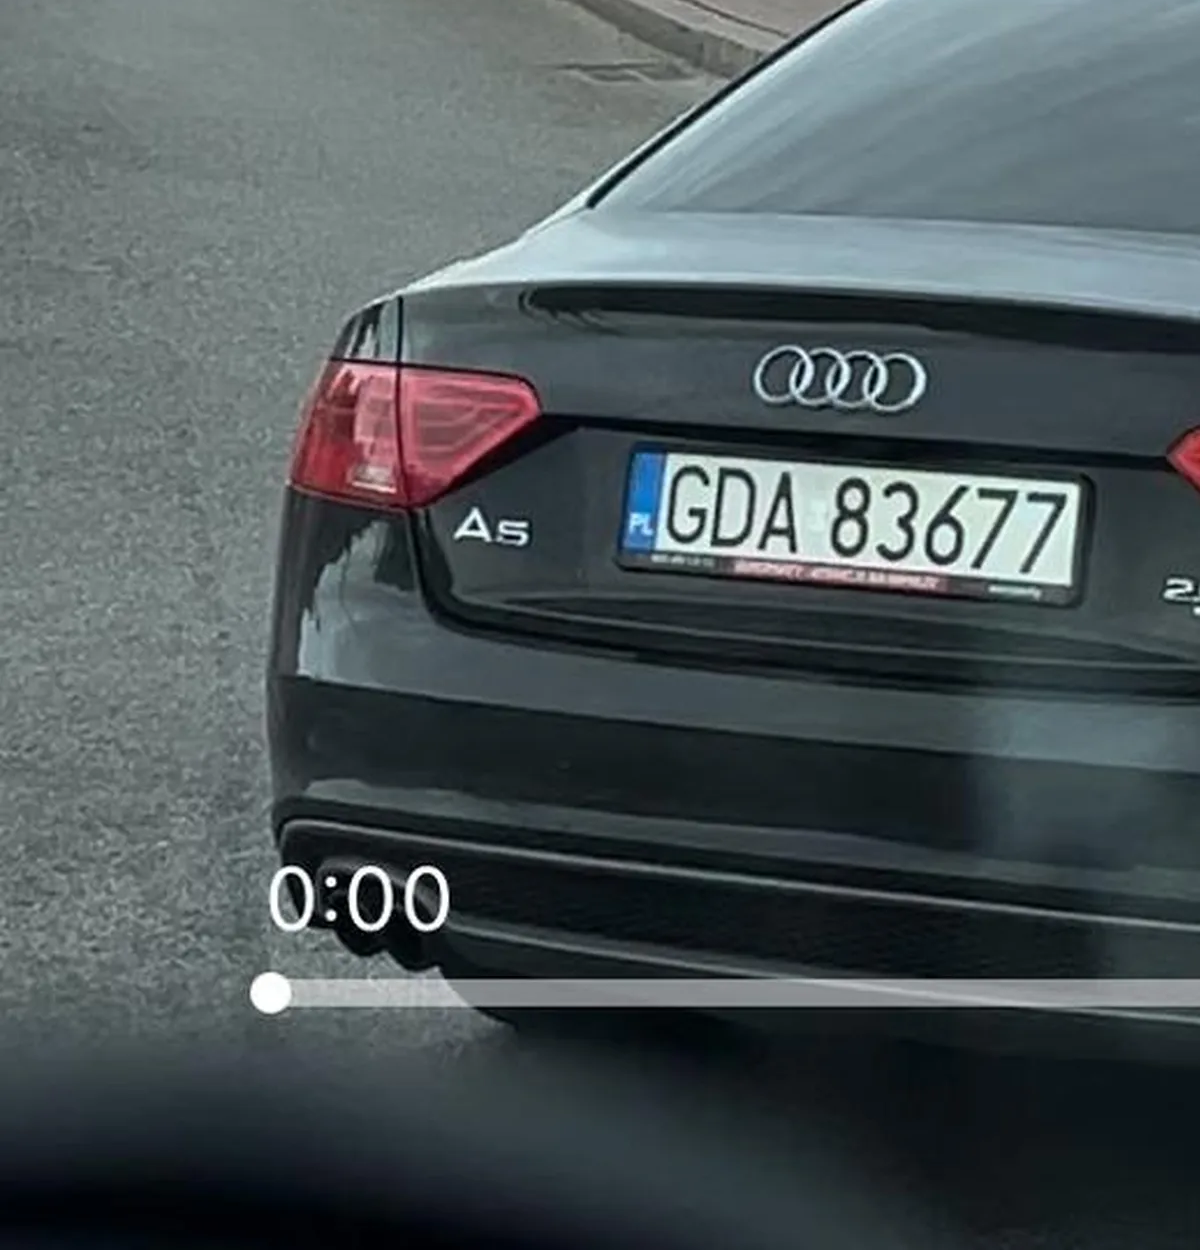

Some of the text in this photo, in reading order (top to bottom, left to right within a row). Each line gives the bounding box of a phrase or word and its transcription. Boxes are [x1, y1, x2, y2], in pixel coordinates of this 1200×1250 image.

[453, 506, 529, 547] A5
[629, 512, 654, 536] PL
[666, 465, 1068, 574] GDA 83677
